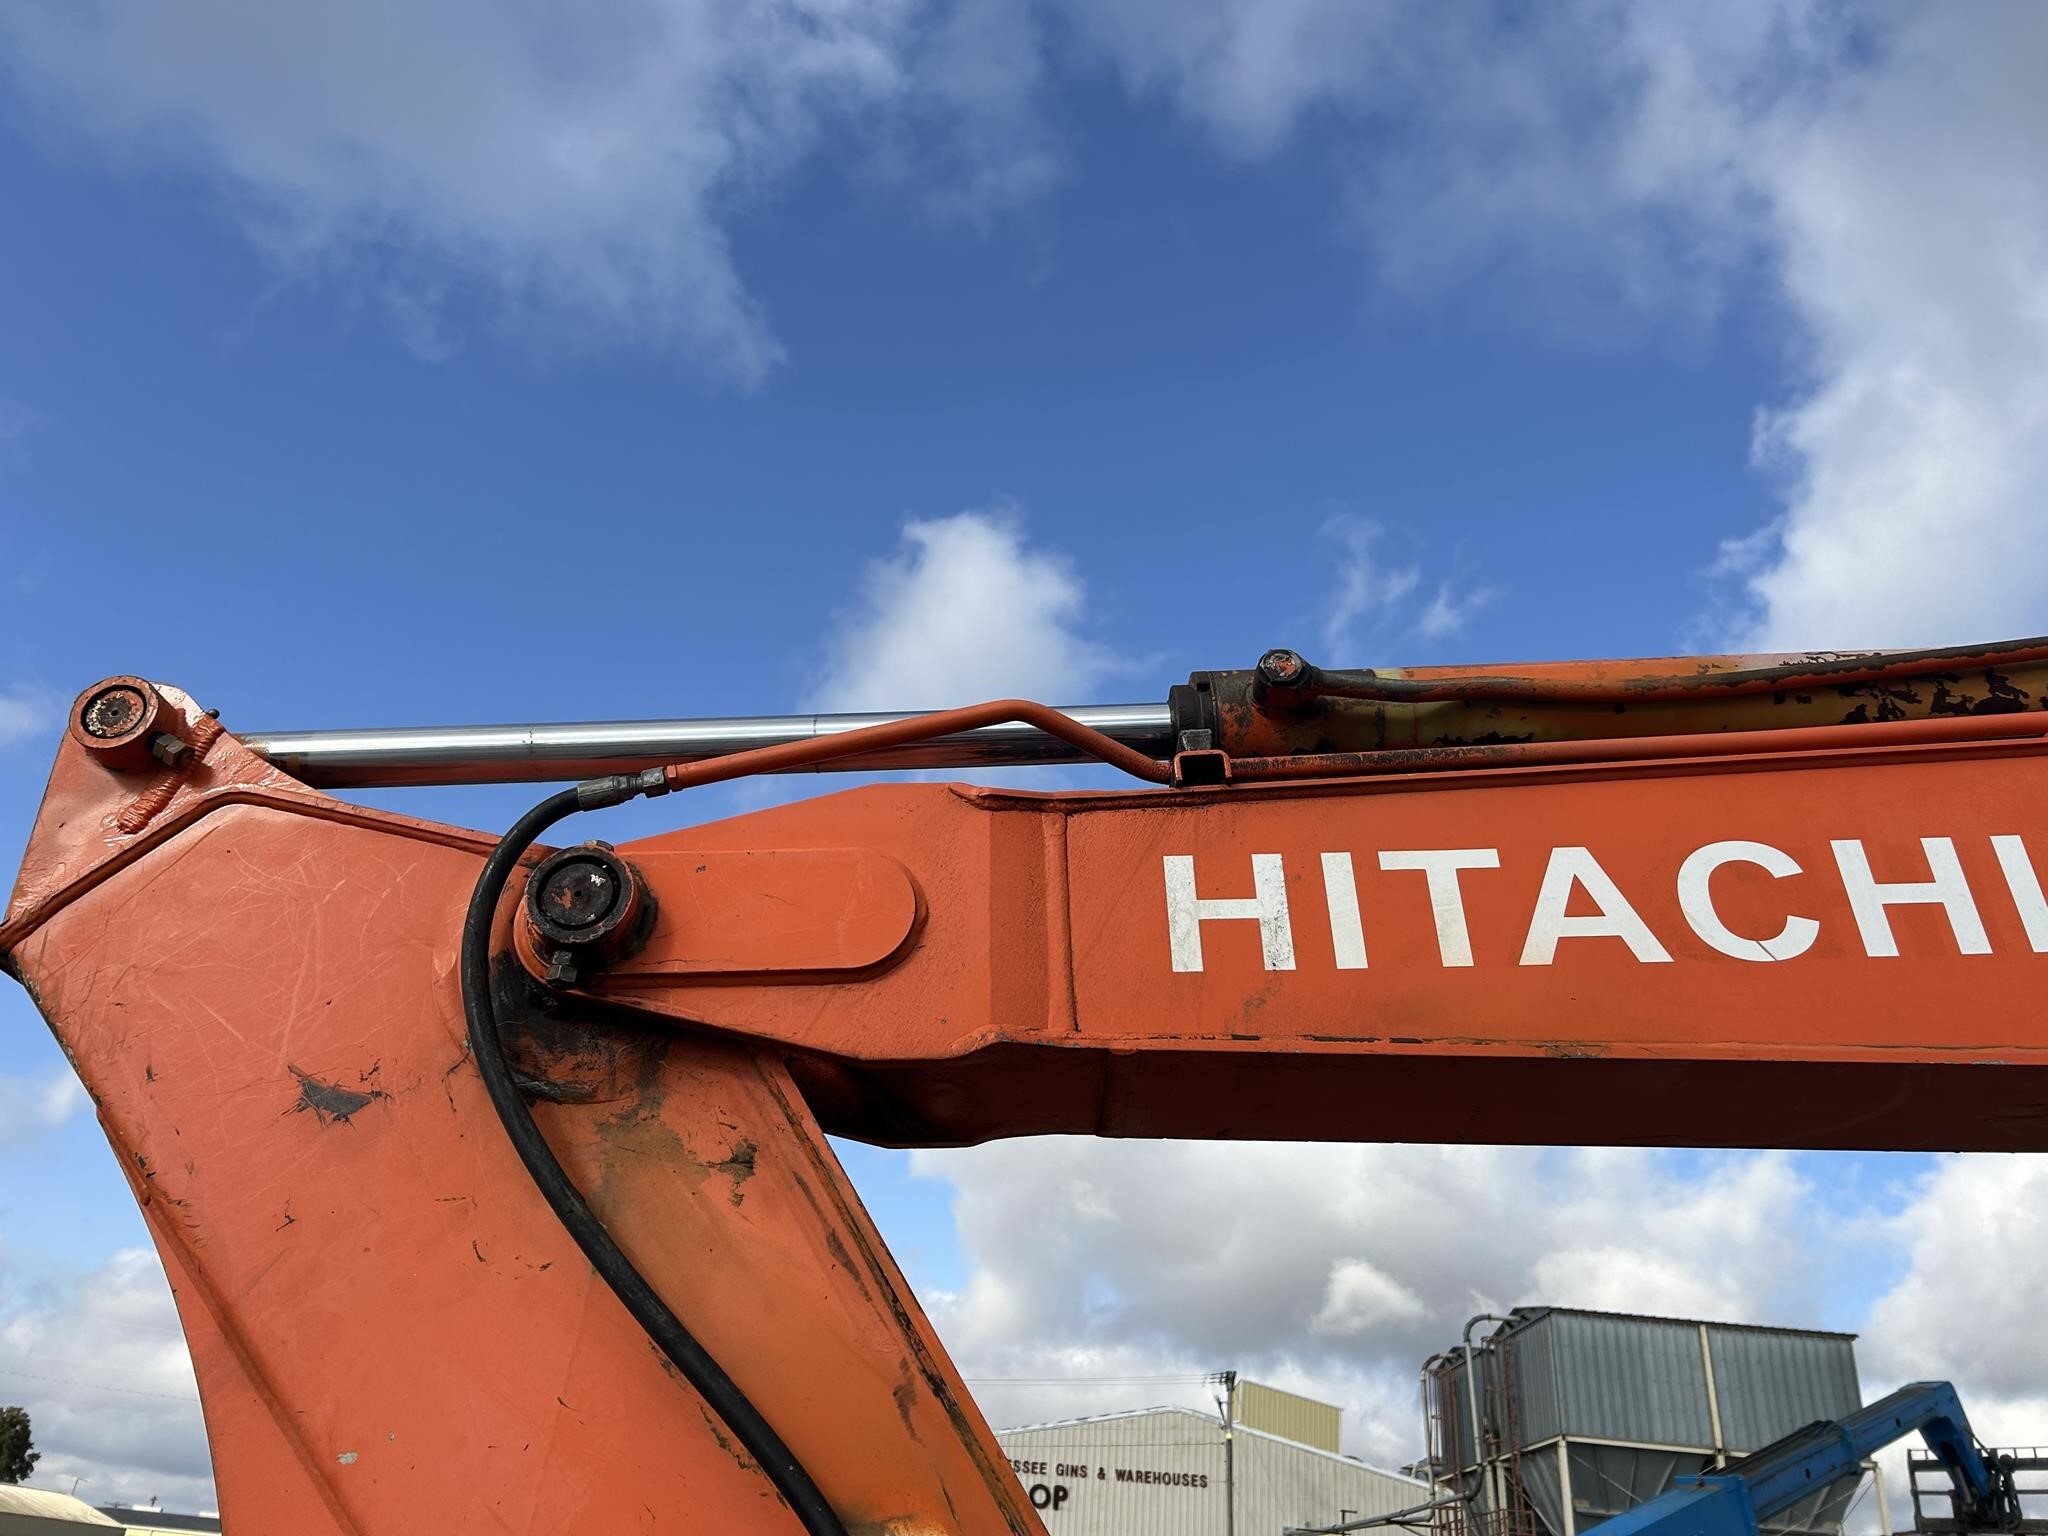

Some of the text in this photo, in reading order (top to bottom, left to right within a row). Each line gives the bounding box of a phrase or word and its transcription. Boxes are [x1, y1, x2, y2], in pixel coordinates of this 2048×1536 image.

[1163, 835, 2048, 973] HITACHI
[1008, 1460, 1208, 1488] SSEE GINS & WAREHOUSES
